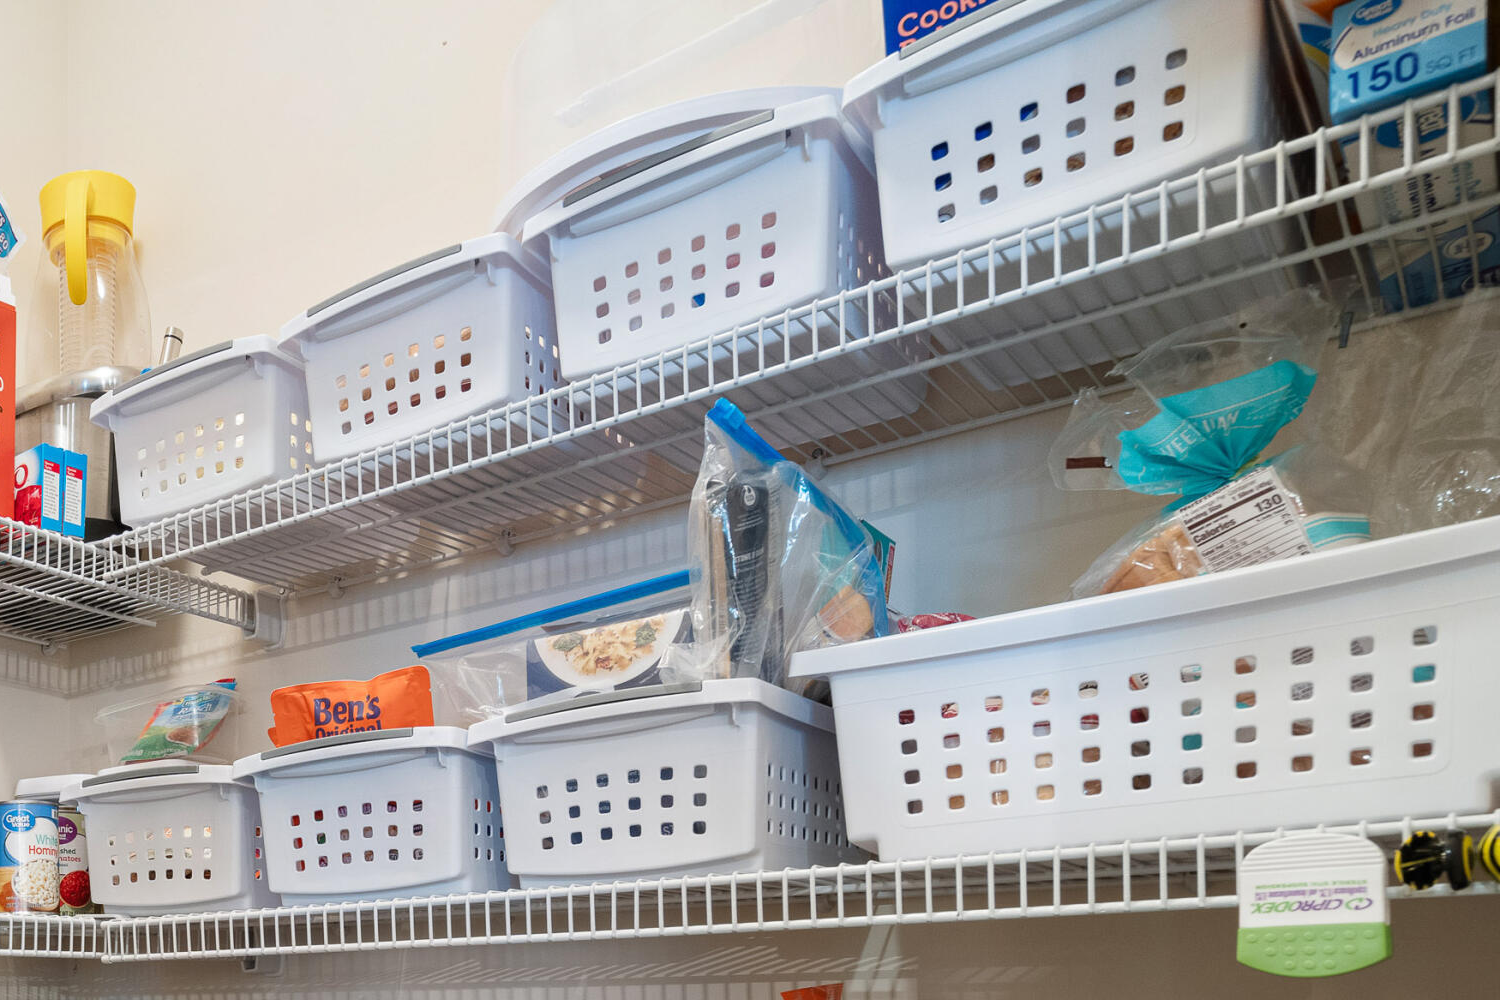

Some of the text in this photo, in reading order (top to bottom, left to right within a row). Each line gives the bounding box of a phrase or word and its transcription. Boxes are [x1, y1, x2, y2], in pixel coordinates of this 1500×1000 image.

[1353, 8, 1476, 62] Aluminum Foil
[1348, 45, 1478, 99] 150 SQ FT
[1193, 493, 1283, 544] Calories 130
[313, 694, 381, 727] Ben's
[5, 814, 30, 824] Great
[35, 833, 58, 845] White
[1251, 898, 1343, 915] CIPRODEX
